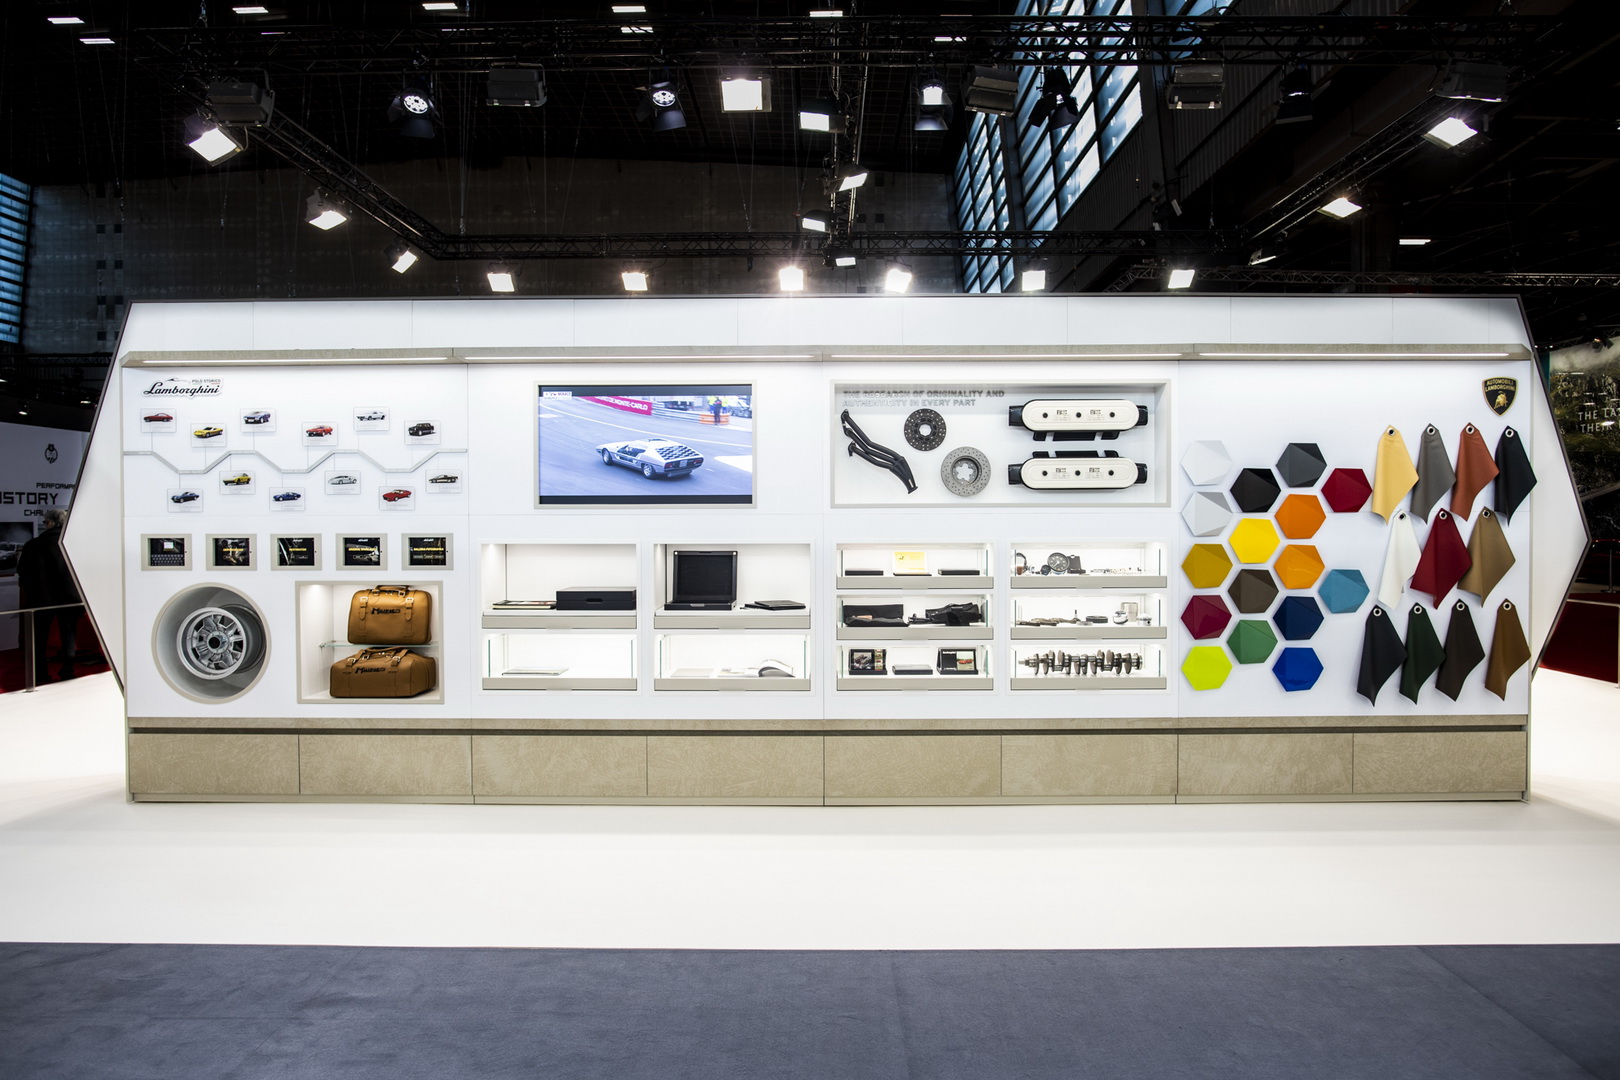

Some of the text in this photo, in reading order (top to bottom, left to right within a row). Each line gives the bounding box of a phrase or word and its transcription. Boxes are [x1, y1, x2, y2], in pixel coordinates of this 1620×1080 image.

[143, 381, 220, 397] Lamborghini
[843, 390, 861, 399] THE
[912, 390, 925, 398] OF
[926, 390, 984, 398] ORIGINALITY
[986, 390, 1005, 398] AND
[921, 399, 951, 407] EVERY
[953, 399, 976, 407] PART
[1577, 409, 1598, 421] THE
